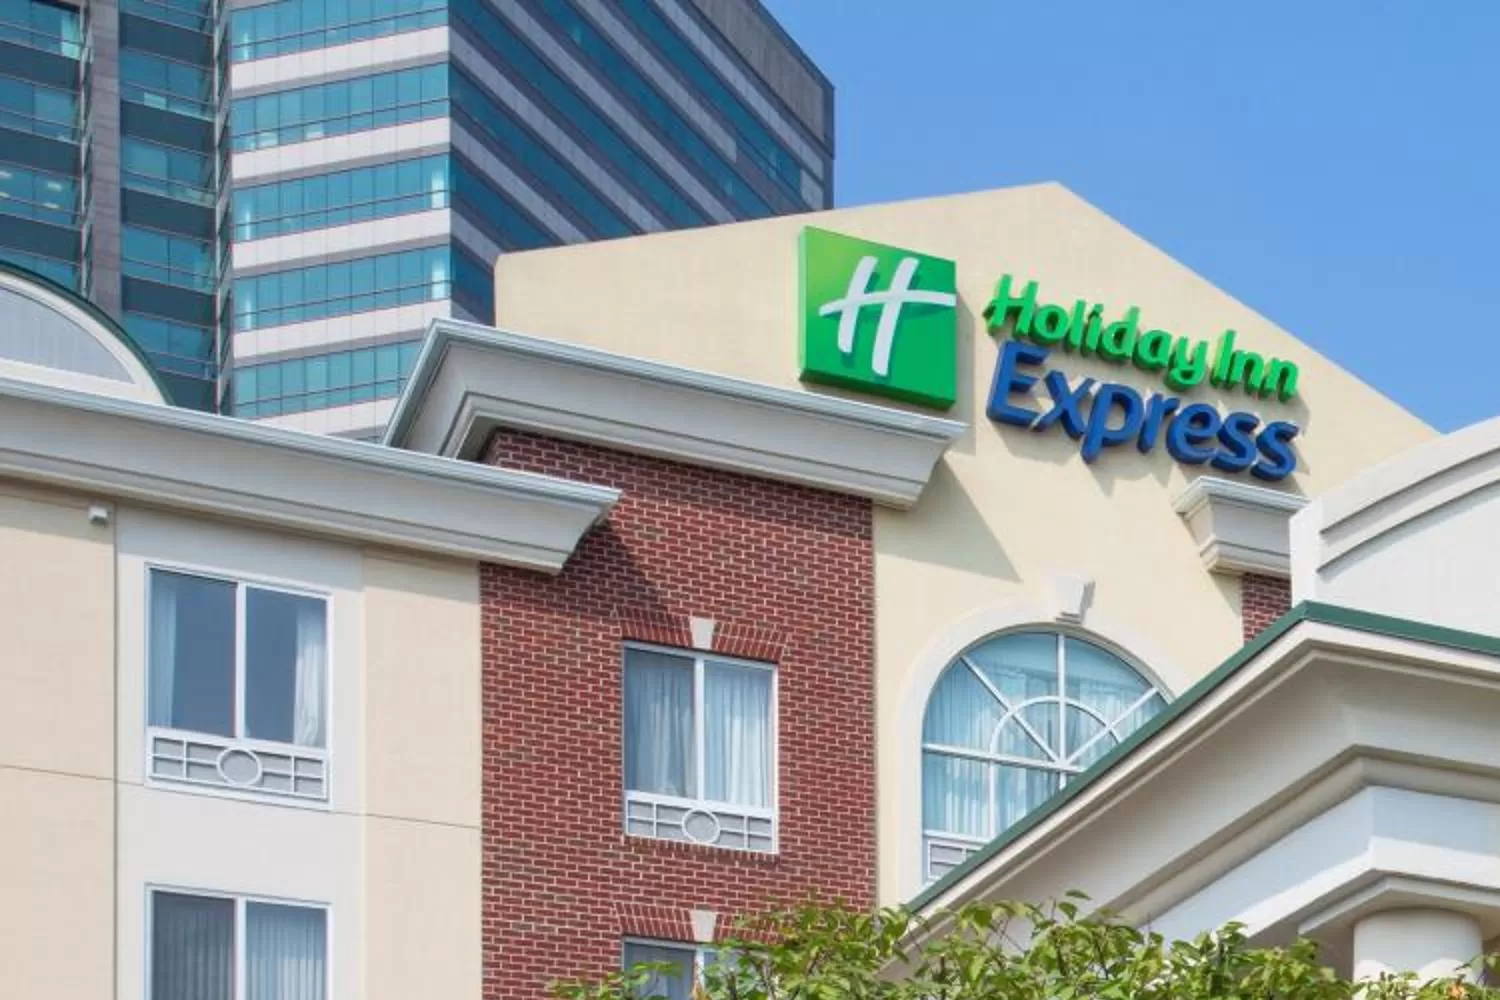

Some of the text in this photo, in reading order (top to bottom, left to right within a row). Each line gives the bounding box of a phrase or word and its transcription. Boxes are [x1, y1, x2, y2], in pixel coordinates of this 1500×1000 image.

[983, 274, 1299, 402] Holiday Inn
[987, 339, 1300, 481] Express
